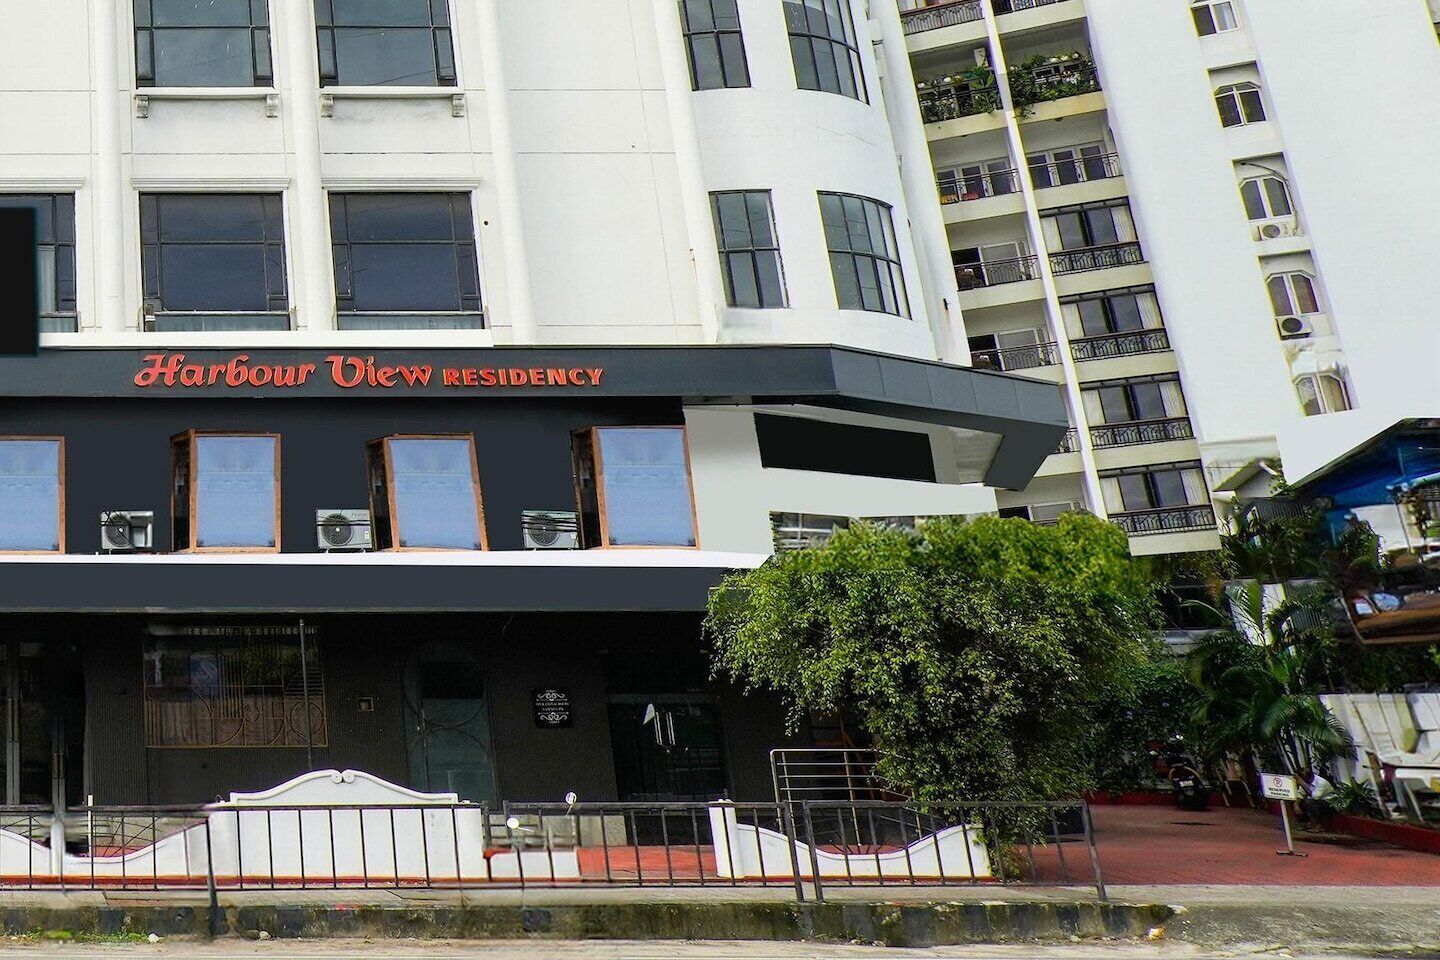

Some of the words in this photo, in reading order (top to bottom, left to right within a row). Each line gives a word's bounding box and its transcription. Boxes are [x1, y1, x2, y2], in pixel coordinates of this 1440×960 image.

[134, 353, 316, 387] Harbour
[325, 355, 433, 387] View
[443, 367, 604, 387] RESIDENCY
